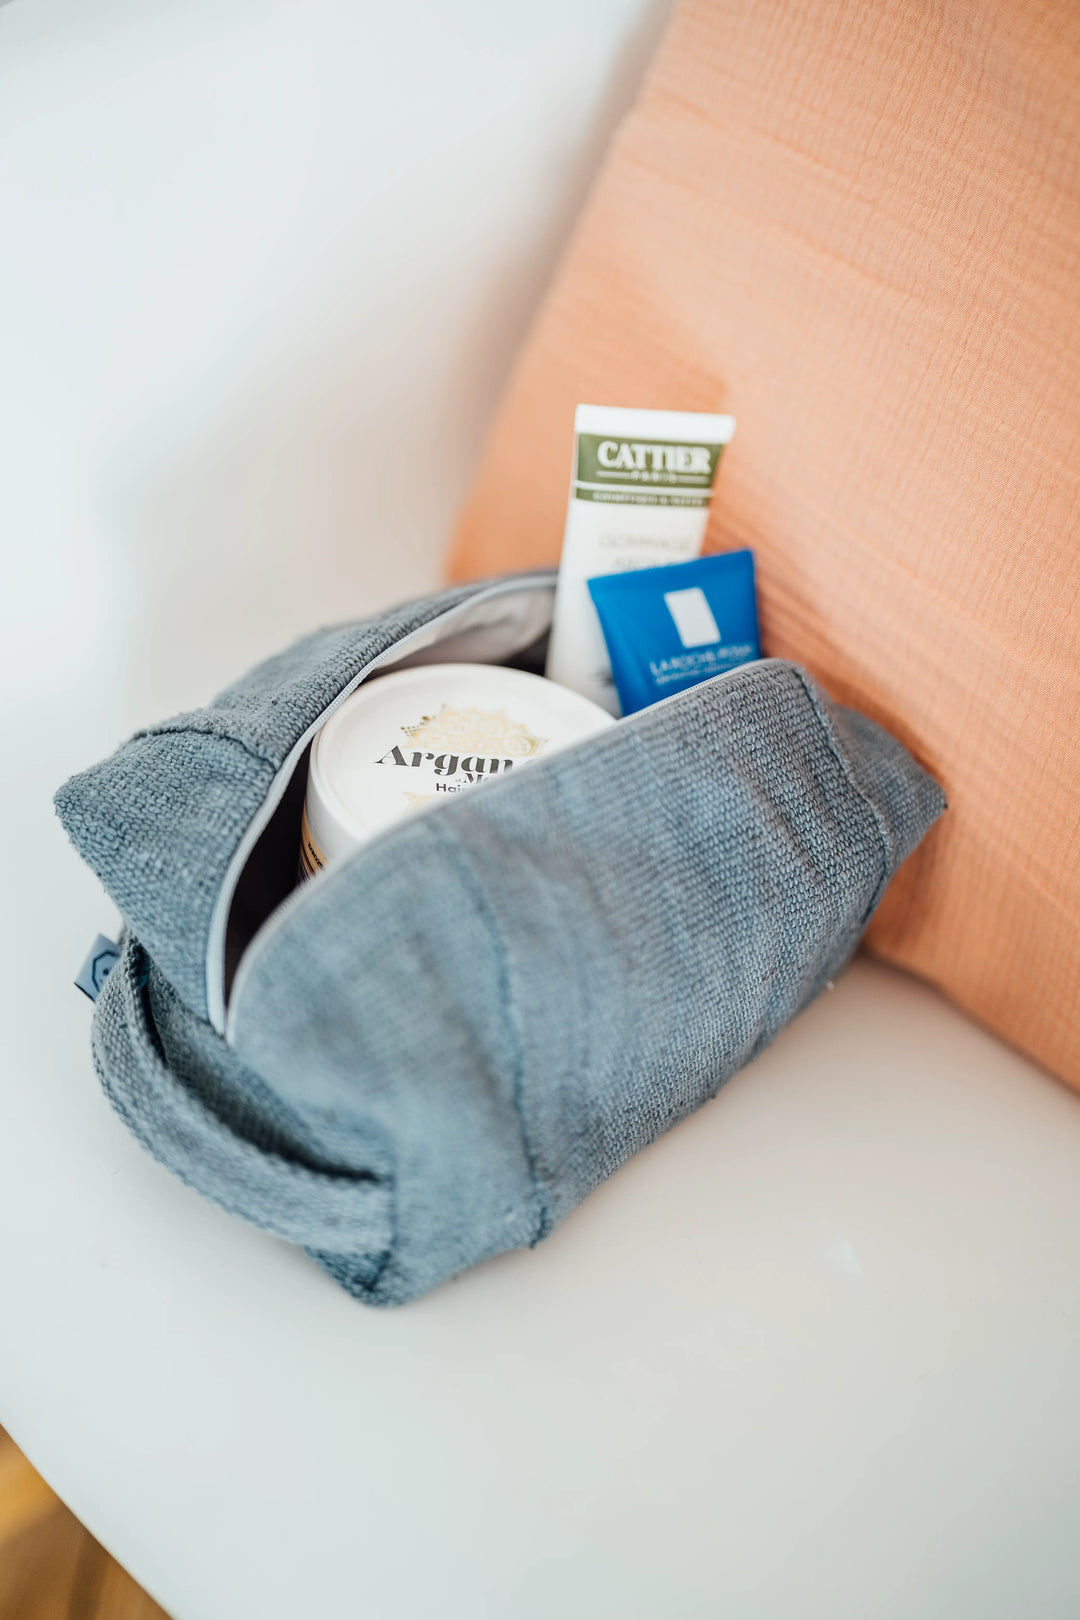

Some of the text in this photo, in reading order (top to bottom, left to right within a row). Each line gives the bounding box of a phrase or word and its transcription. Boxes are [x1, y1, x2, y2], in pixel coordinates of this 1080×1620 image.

[597, 440, 711, 474] CATTIER
[650, 659, 669, 677] LA
[374, 745, 514, 776] Argan
